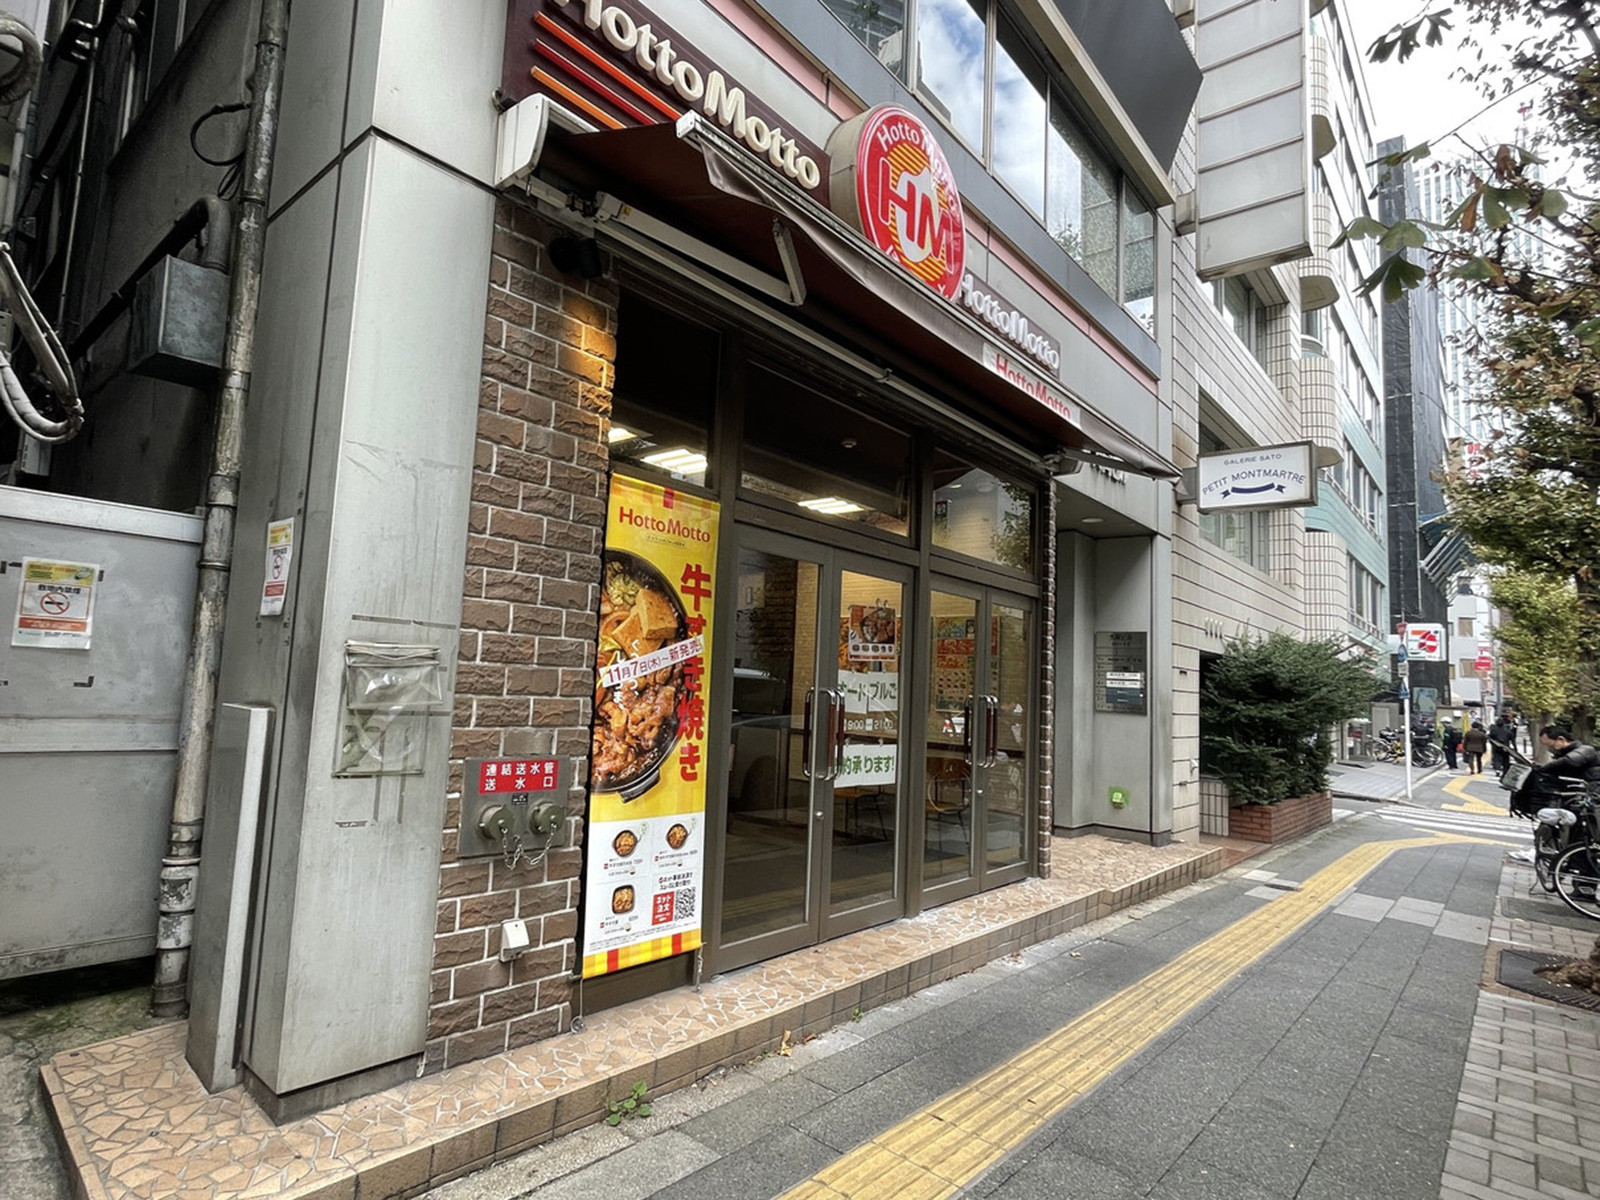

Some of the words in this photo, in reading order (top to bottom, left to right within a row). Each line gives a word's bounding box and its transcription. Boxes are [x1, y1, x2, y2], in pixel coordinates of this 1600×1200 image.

[1224, 457, 1257, 466] GALERIE
[1260, 453, 1282, 463] SATO
[1202, 476, 1227, 495] PETIT
[1231, 469, 1306, 485] MONTMARTRE
[486, 762, 554, 777] 連結送水管
